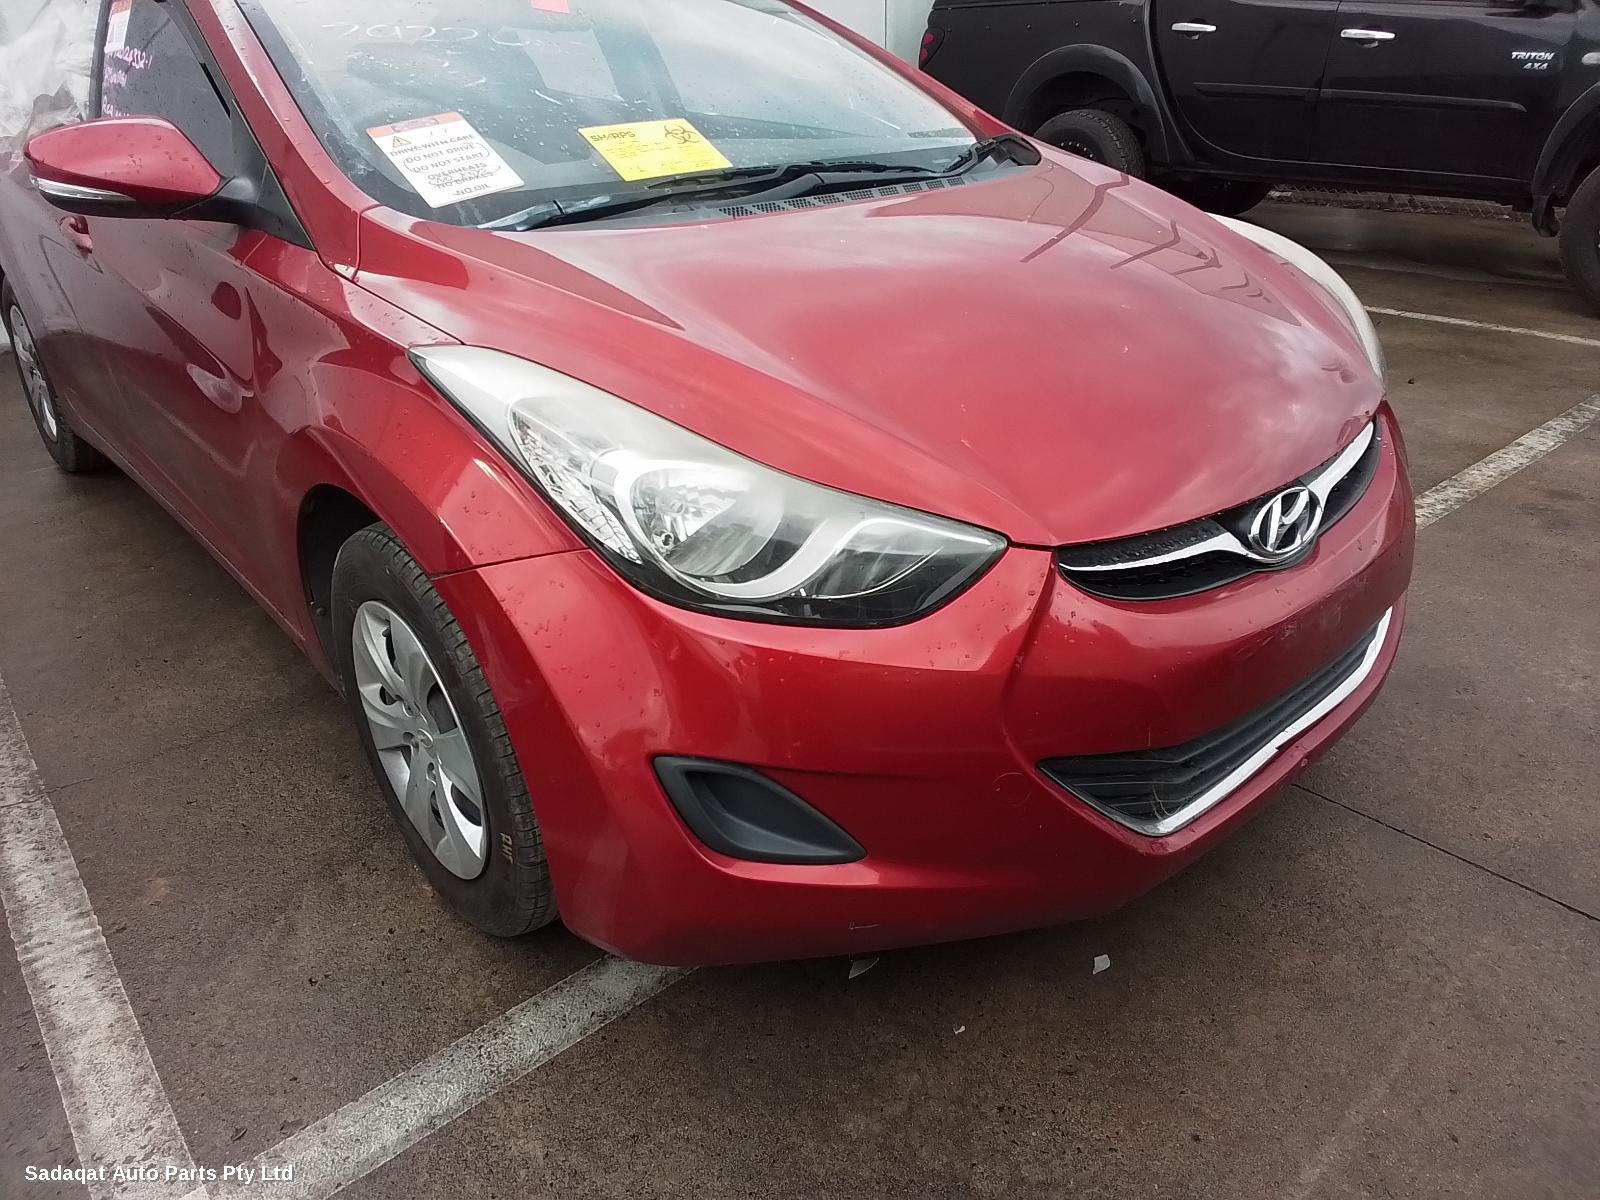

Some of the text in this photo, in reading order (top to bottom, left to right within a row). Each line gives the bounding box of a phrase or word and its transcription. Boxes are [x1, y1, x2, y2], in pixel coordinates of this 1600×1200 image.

[1511, 51, 1555, 60] TRITON
[1523, 62, 1549, 70] 4X4
[390, 133, 475, 157] DRIVE WITH CARE
[405, 143, 477, 164] DO NOT DRIVE
[413, 152, 485, 173] DO NOT START
